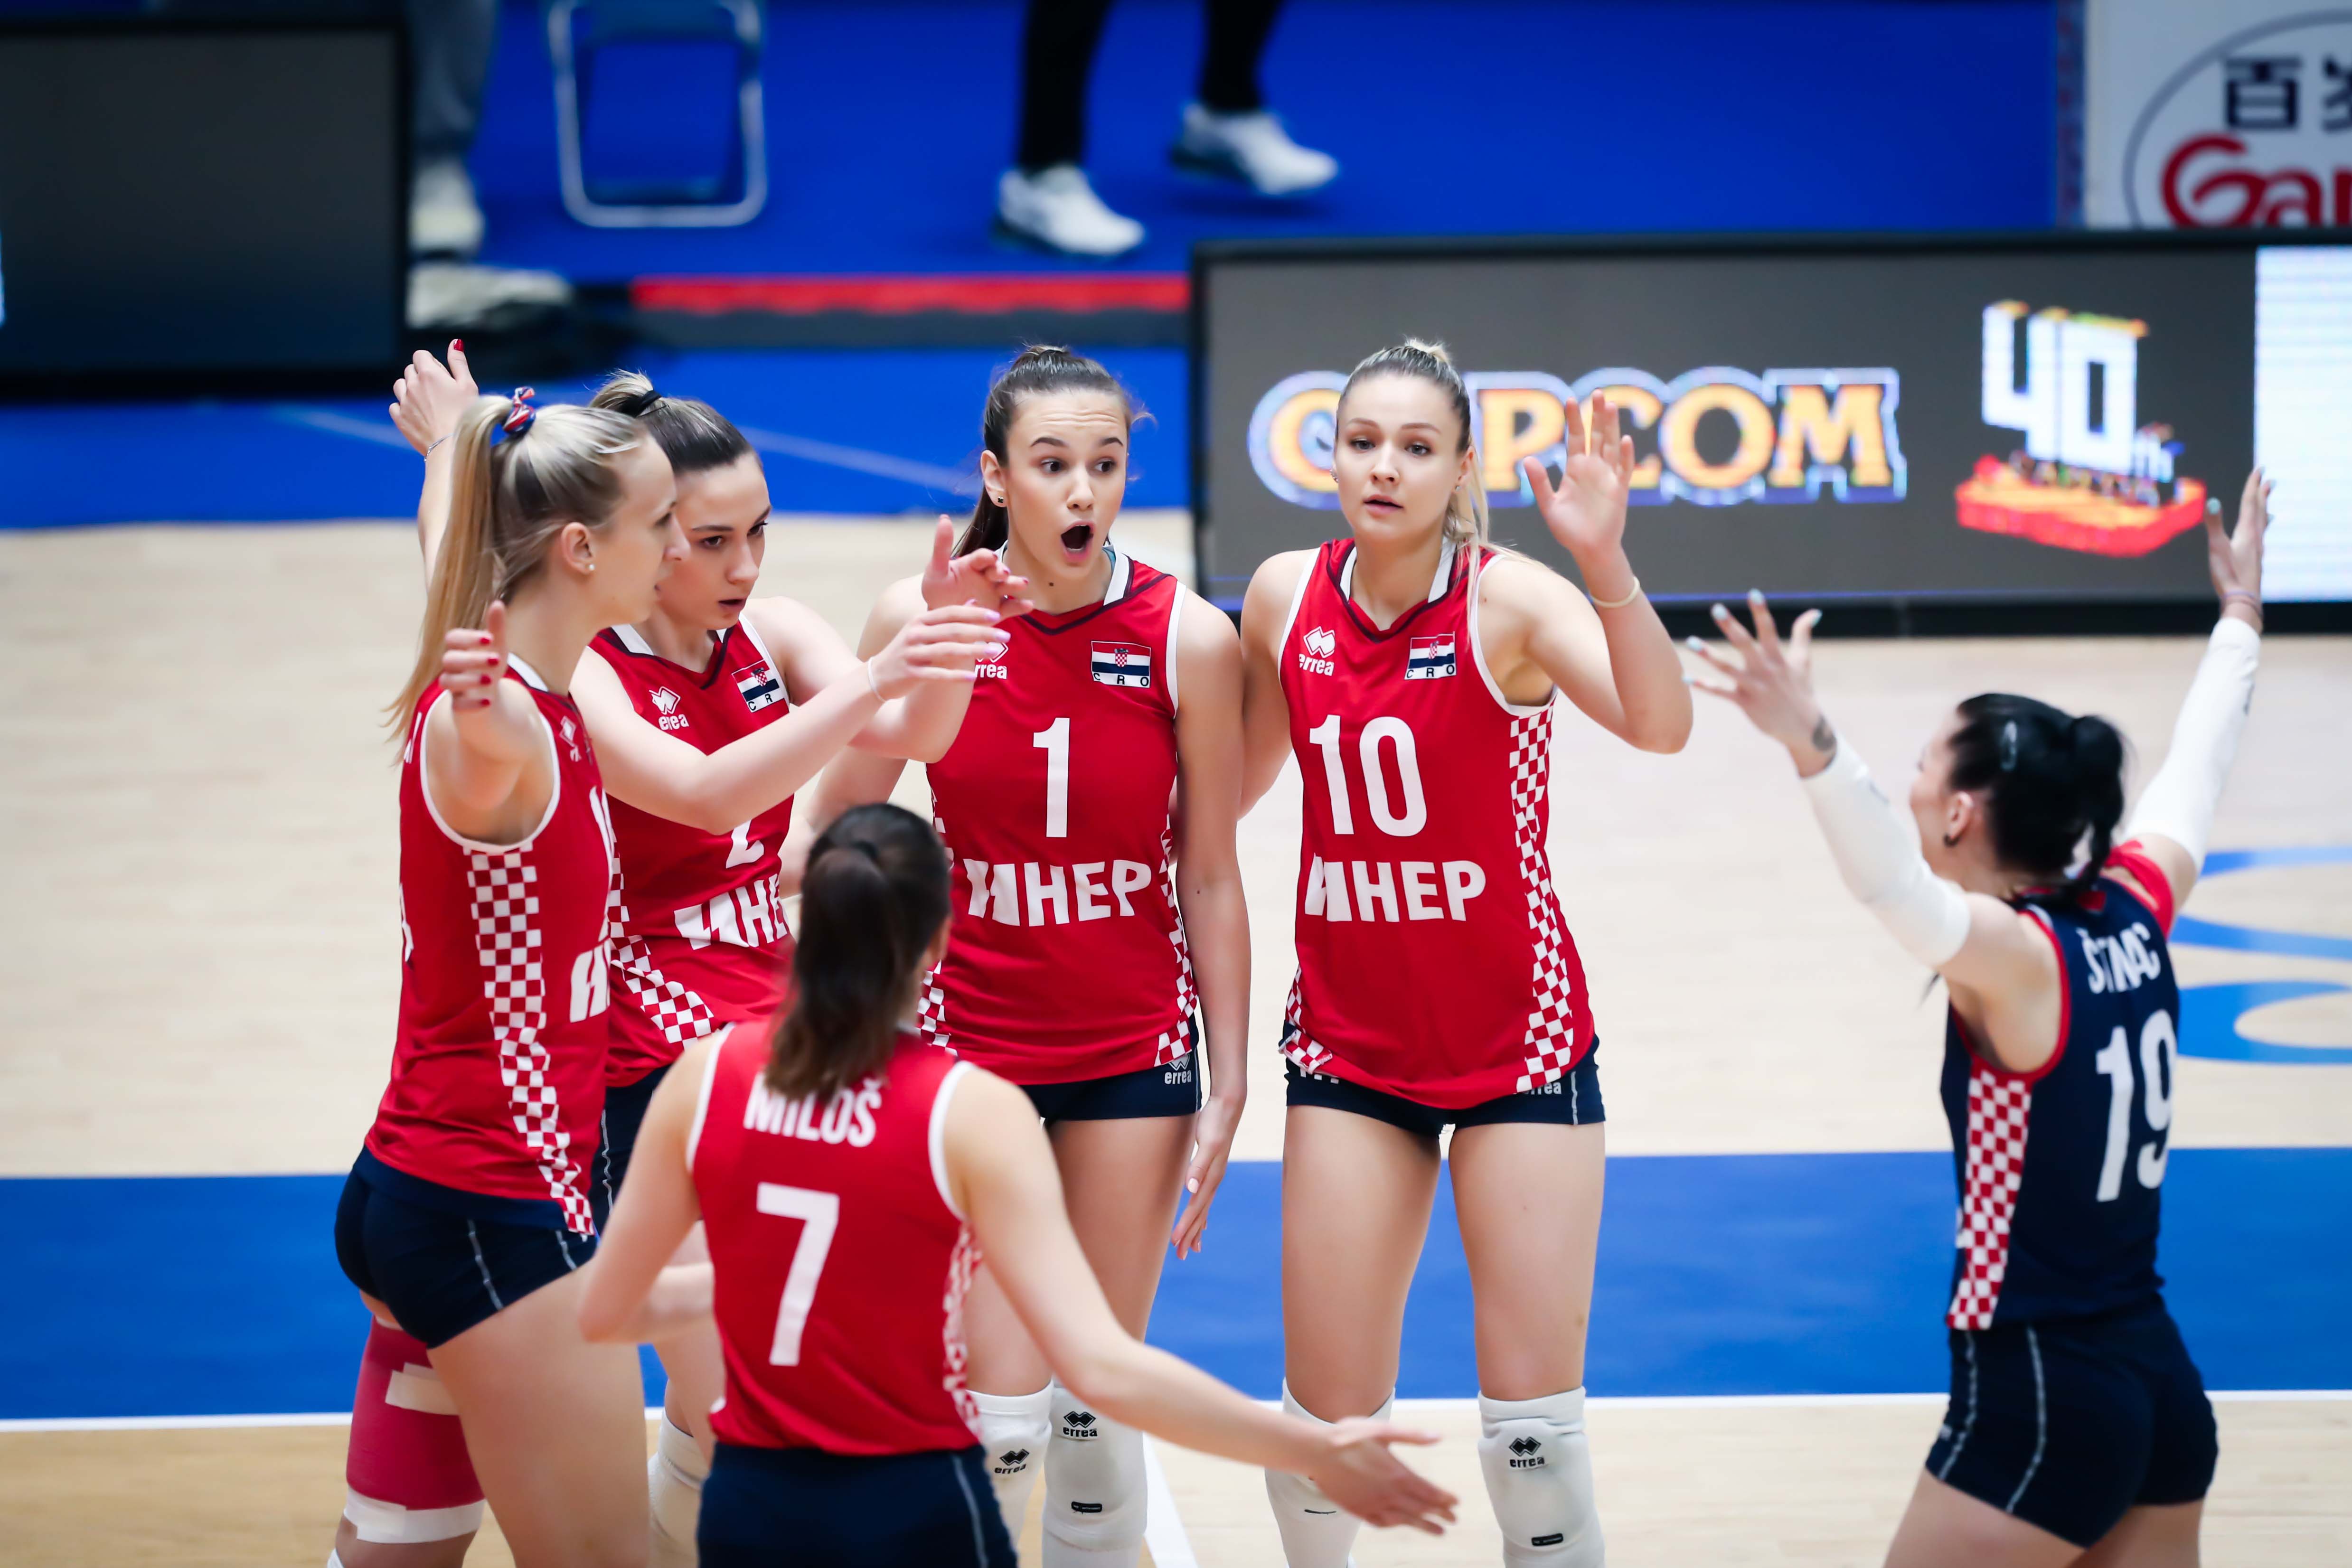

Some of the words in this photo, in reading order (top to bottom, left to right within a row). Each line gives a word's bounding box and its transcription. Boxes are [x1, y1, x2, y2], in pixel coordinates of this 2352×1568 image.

[975, 664, 1007, 680] rrea
[1033, 717, 1070, 837] 1
[1309, 714, 1427, 837] 10
[2095, 1009, 2178, 1202] 19
[756, 1181, 840, 1367] 7
